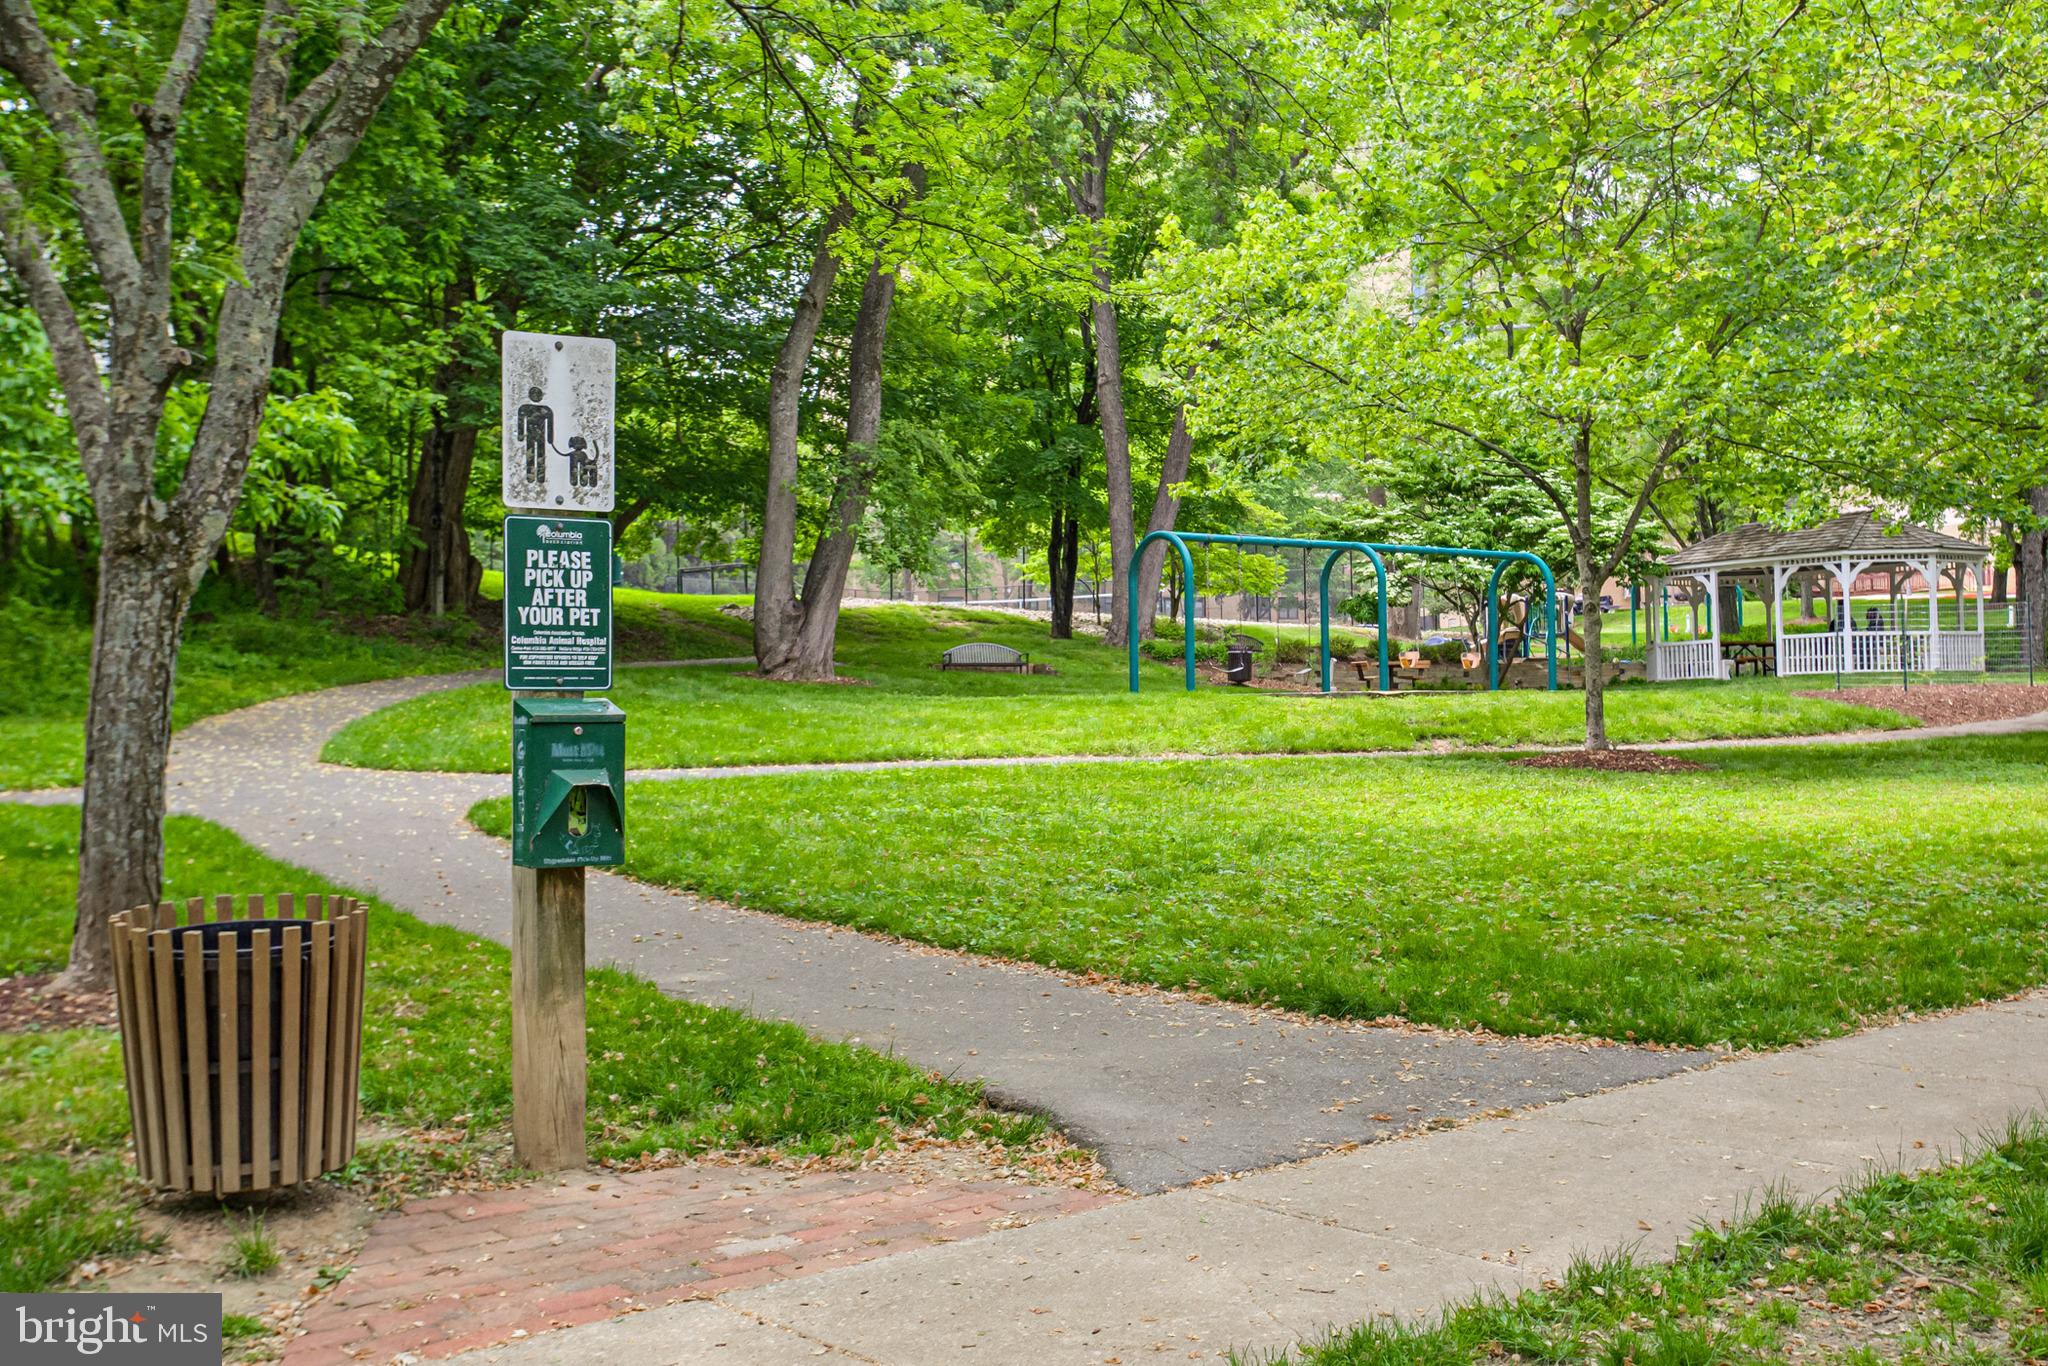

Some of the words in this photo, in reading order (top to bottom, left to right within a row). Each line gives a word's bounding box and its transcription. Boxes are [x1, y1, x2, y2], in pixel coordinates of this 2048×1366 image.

[526, 549, 592, 570] PLEASE
[524, 568, 565, 588] PICK
[570, 570, 593, 589] UP
[531, 587, 587, 608] AFTER
[517, 606, 564, 626] YOUR
[569, 607, 601, 627] PET
[511, 635, 547, 645] Columbia
[548, 636, 575, 645] Animal
[576, 636, 607, 646] Hospital
